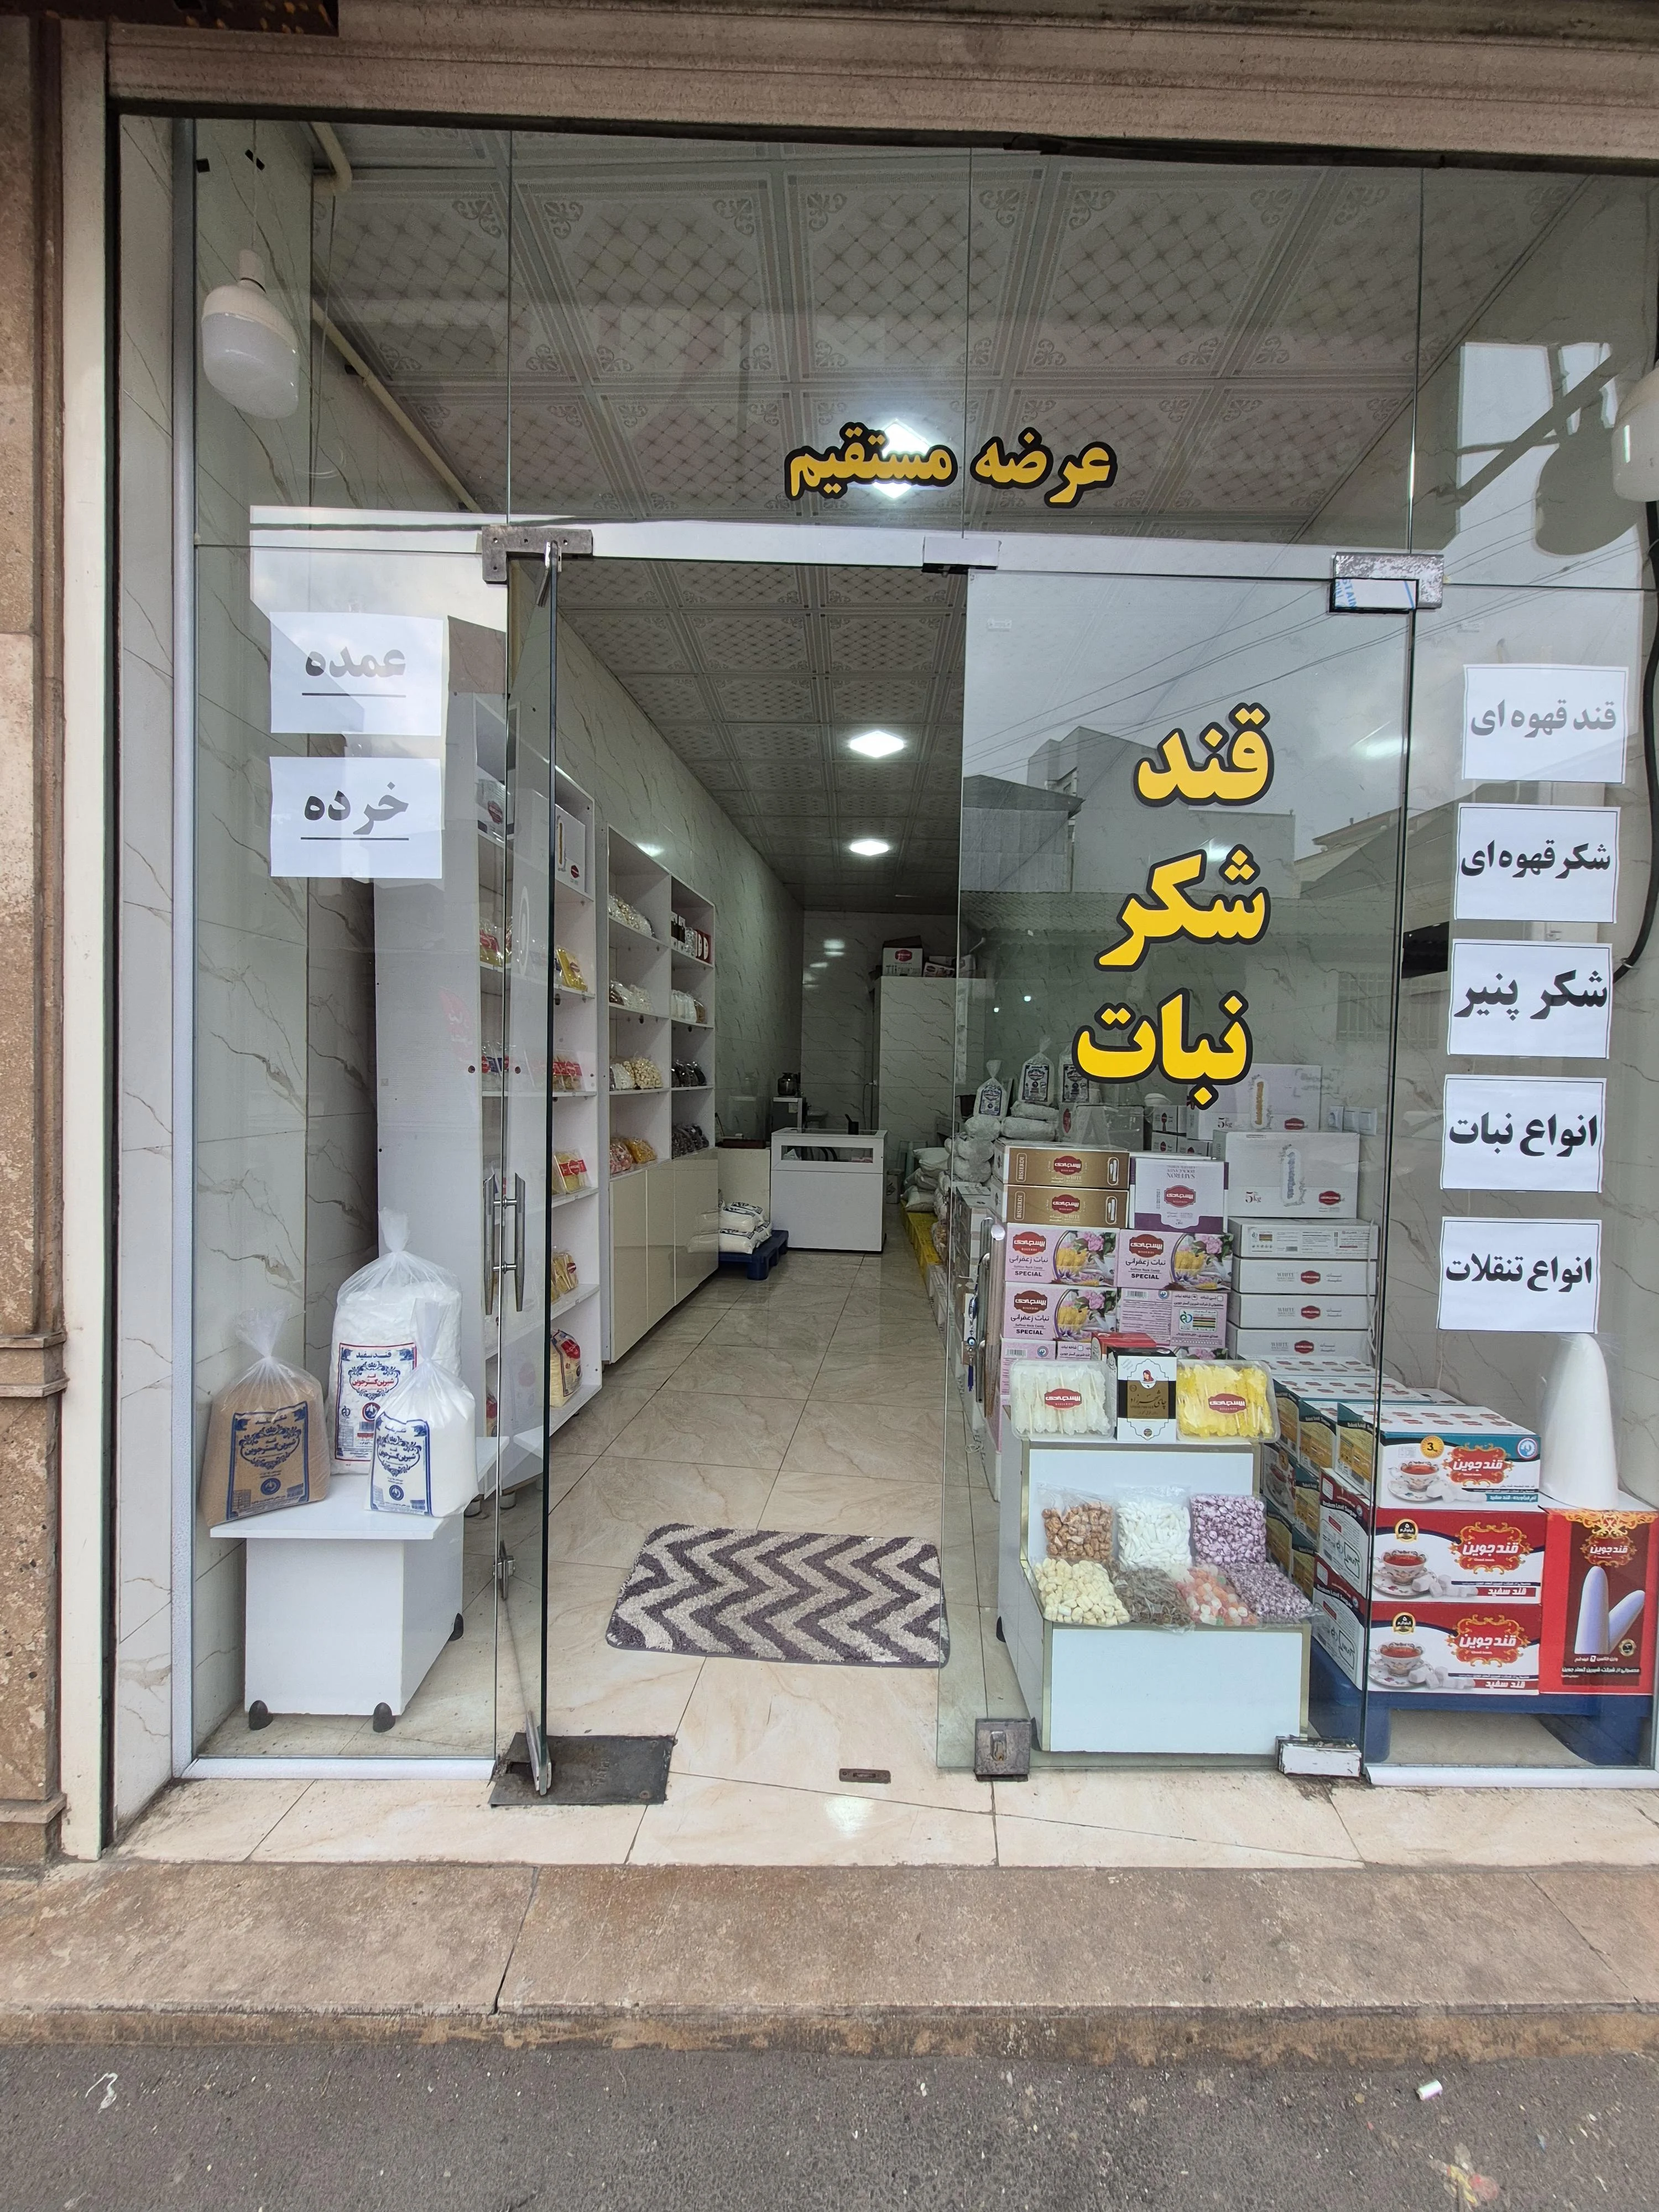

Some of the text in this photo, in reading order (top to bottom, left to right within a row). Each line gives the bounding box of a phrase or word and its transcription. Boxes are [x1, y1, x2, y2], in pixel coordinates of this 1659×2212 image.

[785, 422, 1118, 508] عرضه مستقیم
[305, 646, 406, 677] عمده
[1470, 699, 1616, 738] قند قهوه ای
[1134, 702, 1275, 806] قند
[304, 781, 409, 835] خرده
[1461, 840, 1611, 879] شکر قهوه ای
[1094, 844, 1270, 971] شکر
[1454, 969, 1609, 1021] شکر پنیر
[1072, 988, 1253, 1110] نبات
[1449, 1112, 1597, 1157] انواع نبات
[1125, 1258, 1149, 1266] زعفرانی
[1446, 1253, 1592, 1292] انواع تنقلات
[1453, 1458, 1503, 1472] قند جوین
[1344, 1506, 1357, 1518] Sugar
[1463, 1541, 1519, 1556] قند جوین
[1590, 1545, 1628, 1554] قند جوین
[1488, 1588, 1510, 1597] سفید
[1459, 1634, 1517, 1649] قند جوین
[1485, 1680, 1525, 1689] قند سفید
